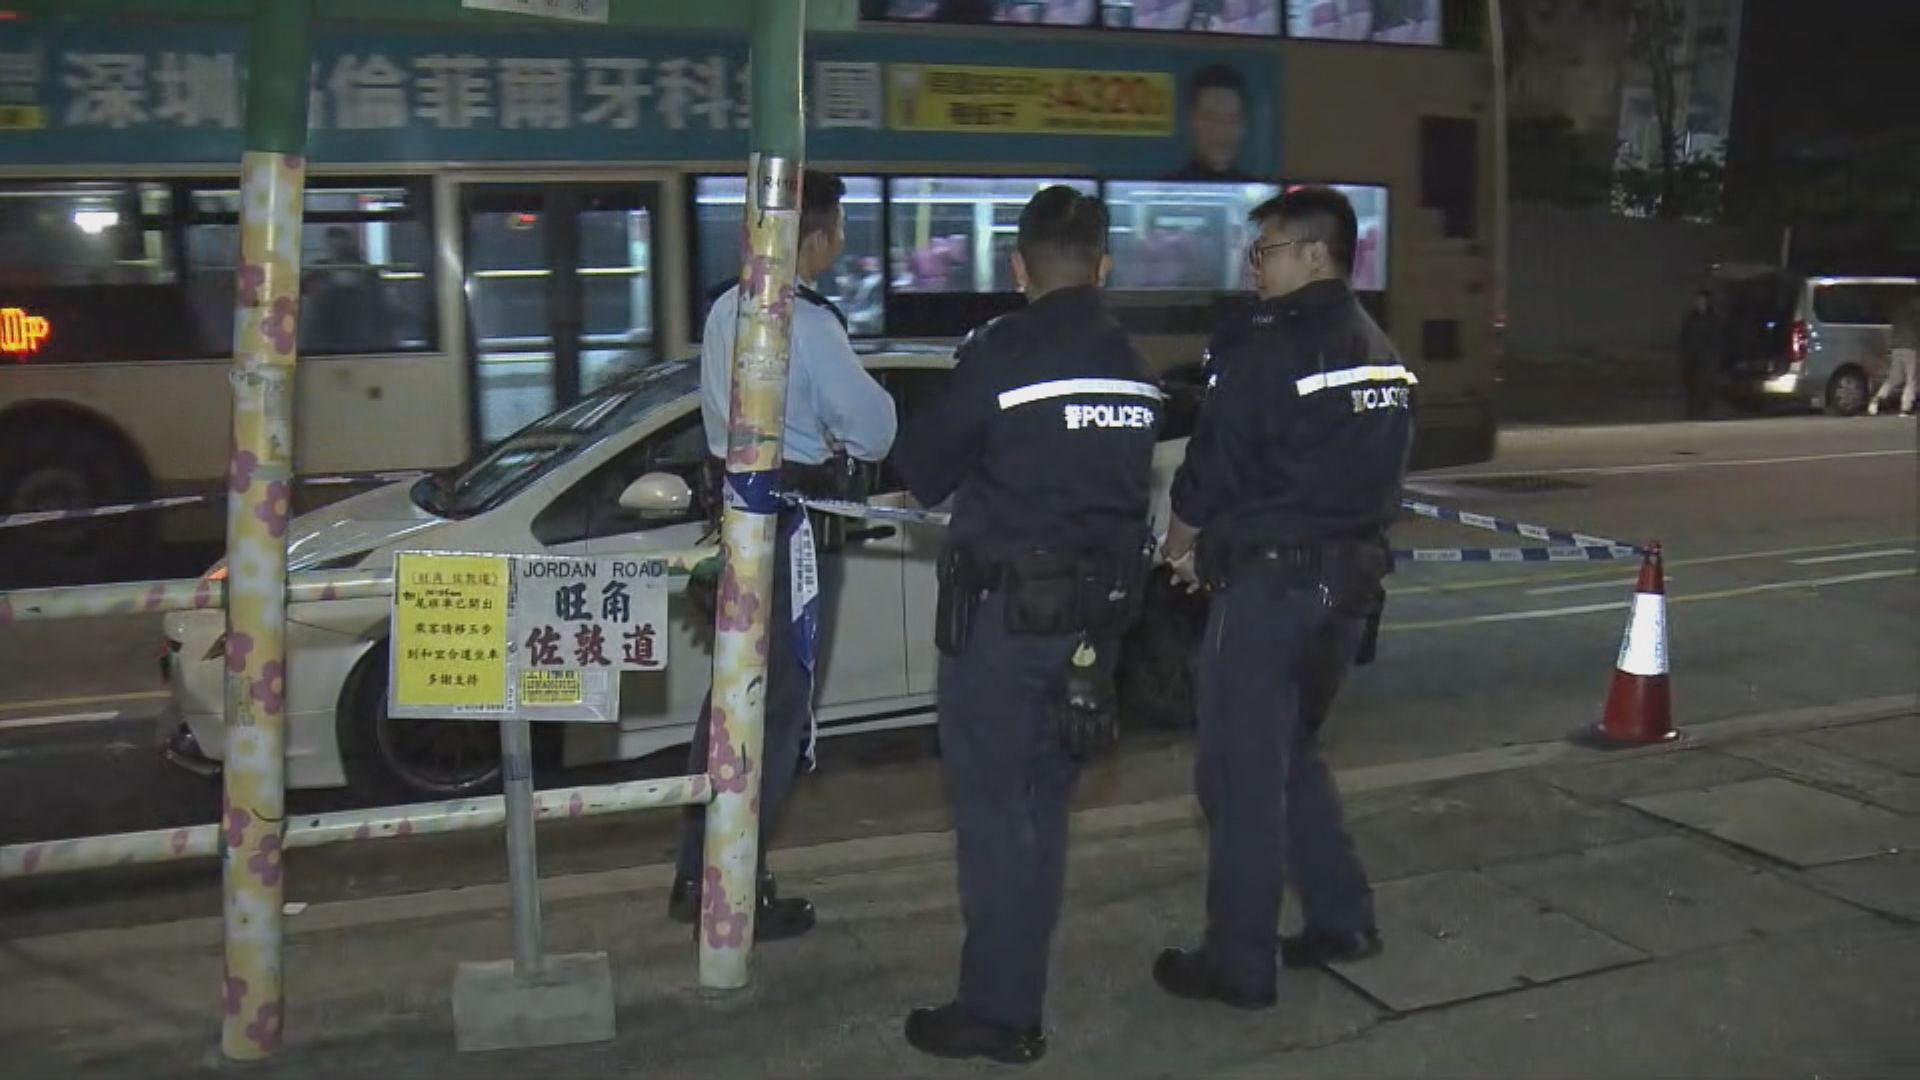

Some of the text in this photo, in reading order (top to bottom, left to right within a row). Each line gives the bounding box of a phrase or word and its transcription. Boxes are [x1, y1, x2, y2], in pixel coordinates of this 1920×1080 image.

[523, 562, 663, 578] JORDAN ROAD
[555, 580, 631, 623] 旺角
[525, 623, 659, 667] 佐敦道
